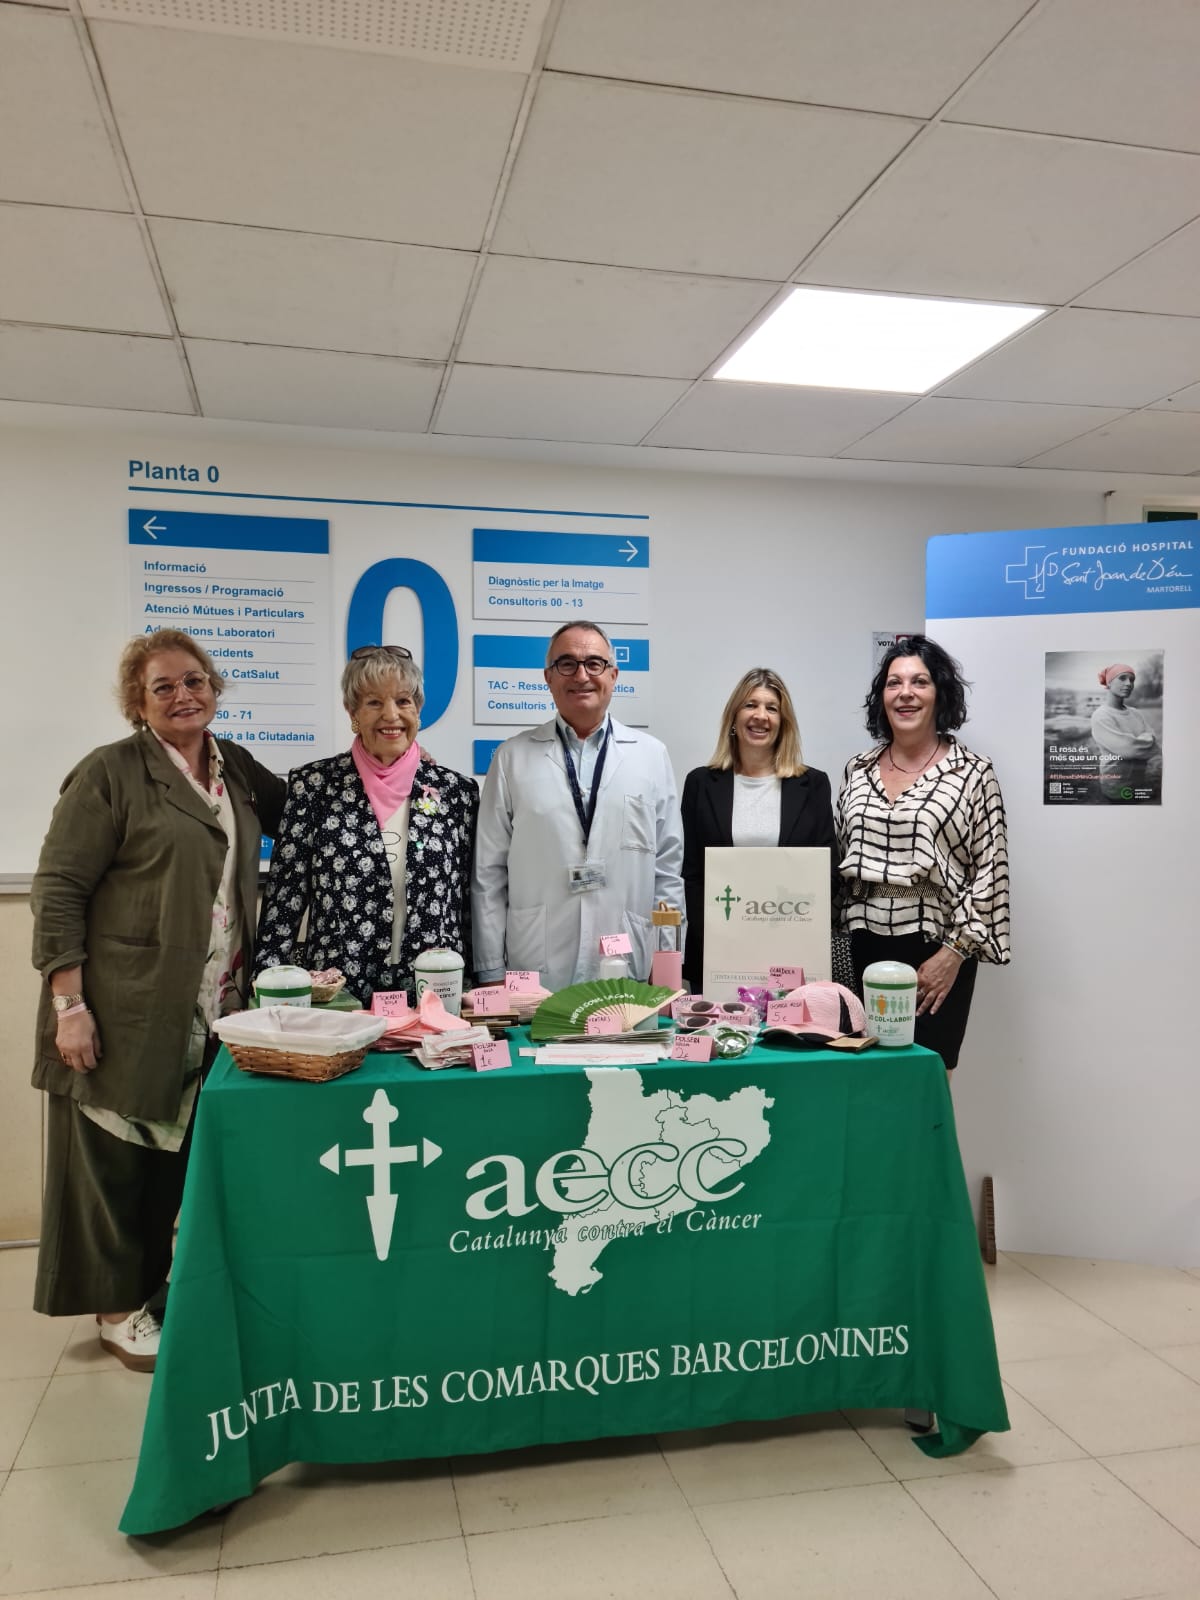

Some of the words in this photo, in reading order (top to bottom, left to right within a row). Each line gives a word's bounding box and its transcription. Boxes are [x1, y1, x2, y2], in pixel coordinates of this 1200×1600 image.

[128, 460, 200, 483] Planta
[207, 466, 220, 483] 0
[1062, 542, 1127, 556] FUNDACIÓ
[1132, 540, 1194, 552] HOSPITAL
[144, 560, 207, 573] Informació
[1129, 562, 1146, 580] de
[144, 581, 202, 595] Ingressos
[212, 584, 284, 598] Programació
[488, 575, 541, 588] Diagnòstic
[543, 578, 559, 589] per
[561, 578, 570, 588] la
[572, 579, 604, 590] Imatge
[488, 595, 548, 607] Consultoris
[550, 597, 562, 607] 00
[571, 598, 583, 608] 13
[144, 603, 190, 614] Atenció
[193, 604, 234, 616] Mútues
[238, 606, 241, 616] i
[244, 607, 305, 619] Particulars
[217, 627, 275, 638] Laboratori
[347, 557, 459, 732] 0
[206, 648, 254, 658] ccidents
[232, 669, 280, 679] CatSalut
[488, 680, 509, 690] TAC
[518, 681, 550, 691] Resso
[488, 700, 547, 710] Consultoris
[216, 710, 229, 720] 50
[240, 710, 252, 720] 71
[246, 731, 255, 740] la
[258, 731, 315, 742] Ciutadania
[1068, 755, 1085, 763] que
[745, 900, 810, 916] aecc
[465, 1138, 747, 1220] aecc
[449, 1224, 568, 1253] Catalunya
[577, 1220, 646, 1242] contra
[656, 1214, 673, 1234] el
[686, 1208, 762, 1232] Càncer
[205, 1377, 302, 1461] JUNTA
[312, 1381, 361, 1413] DE
[371, 1375, 428, 1412] LES
[441, 1348, 660, 1403] COMARQUES
[670, 1325, 909, 1376] BARCELONINES
